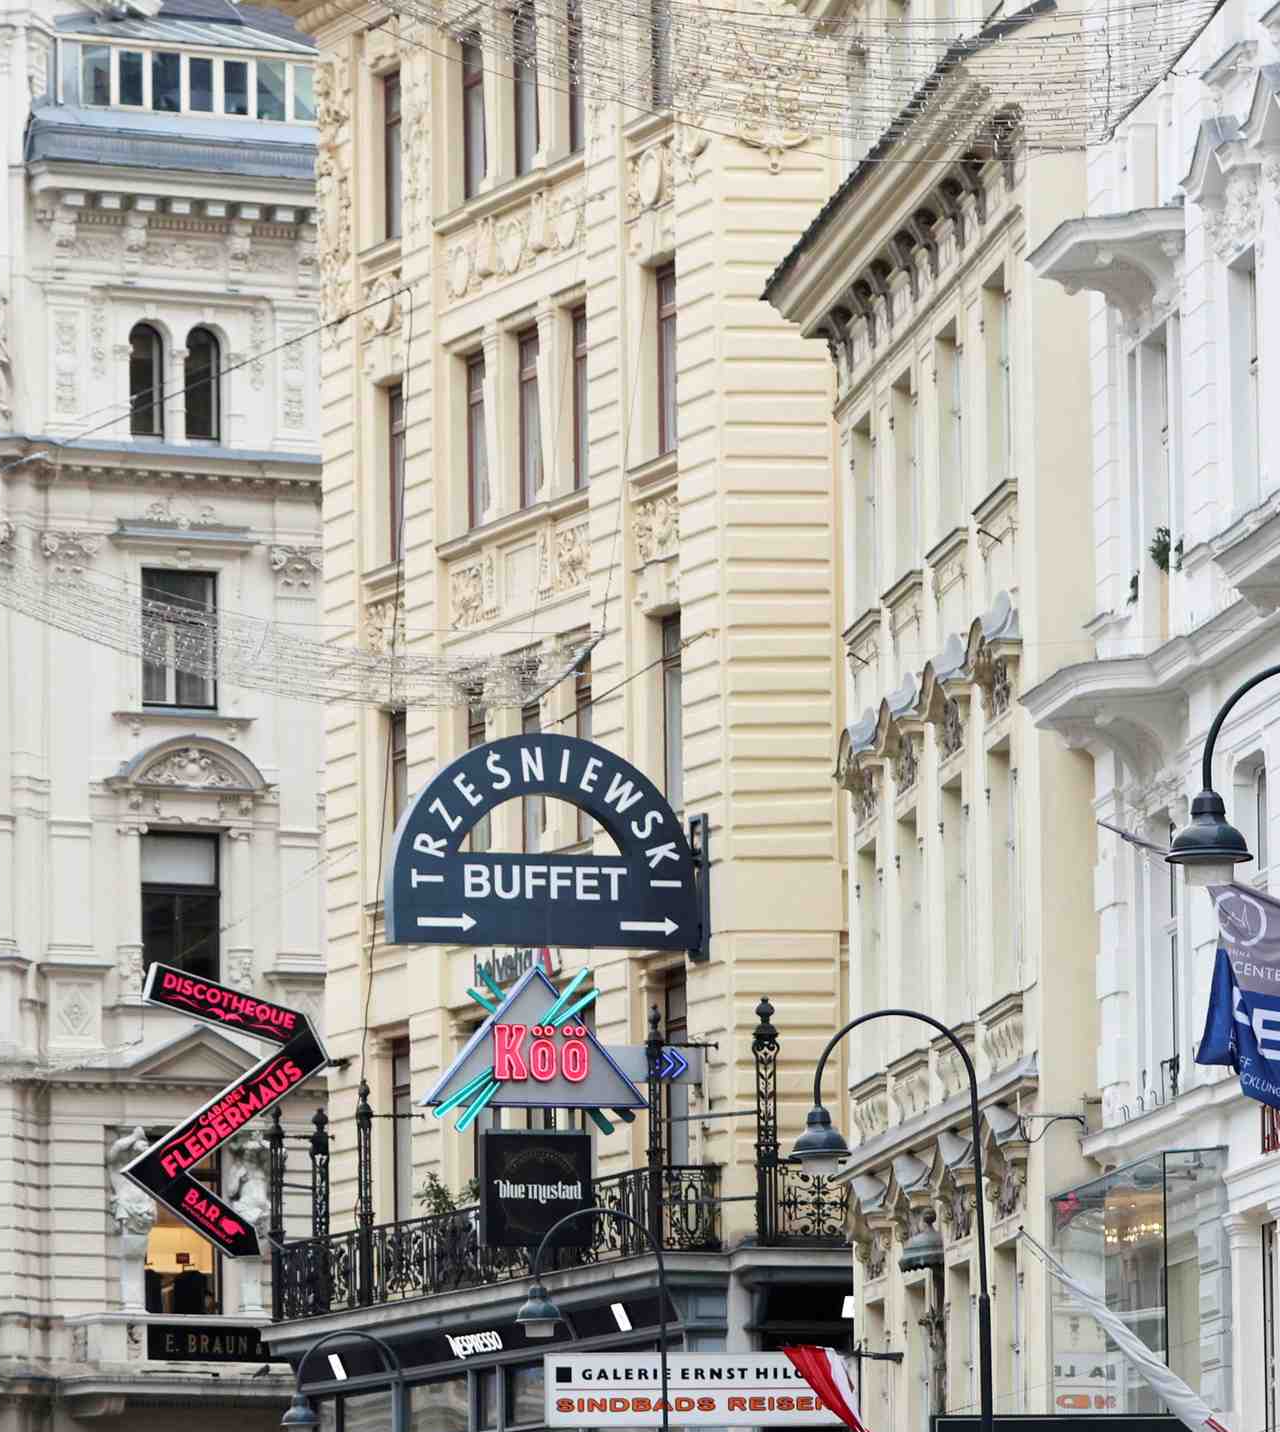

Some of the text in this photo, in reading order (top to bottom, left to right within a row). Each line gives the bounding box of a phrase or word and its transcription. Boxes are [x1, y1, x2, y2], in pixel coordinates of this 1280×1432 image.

[410, 747, 683, 890] TRZEŚNIEWSKI
[463, 863, 628, 901] BUFFET
[162, 972, 297, 1030] DISCOTHEQUE
[493, 1023, 589, 1082] Köö
[160, 1060, 304, 1179] FLEDERMAUS
[199, 1085, 247, 1127] CABARET
[183, 1187, 221, 1222] BAR
[493, 1179, 583, 1205] blue mustard
[165, 1333, 180, 1353] E.
[187, 1333, 248, 1353] BRAUN
[444, 1330, 504, 1361] NESPRESSO
[681, 1366, 748, 1380] ERNST
[555, 1396, 716, 1413] SINDBADS
